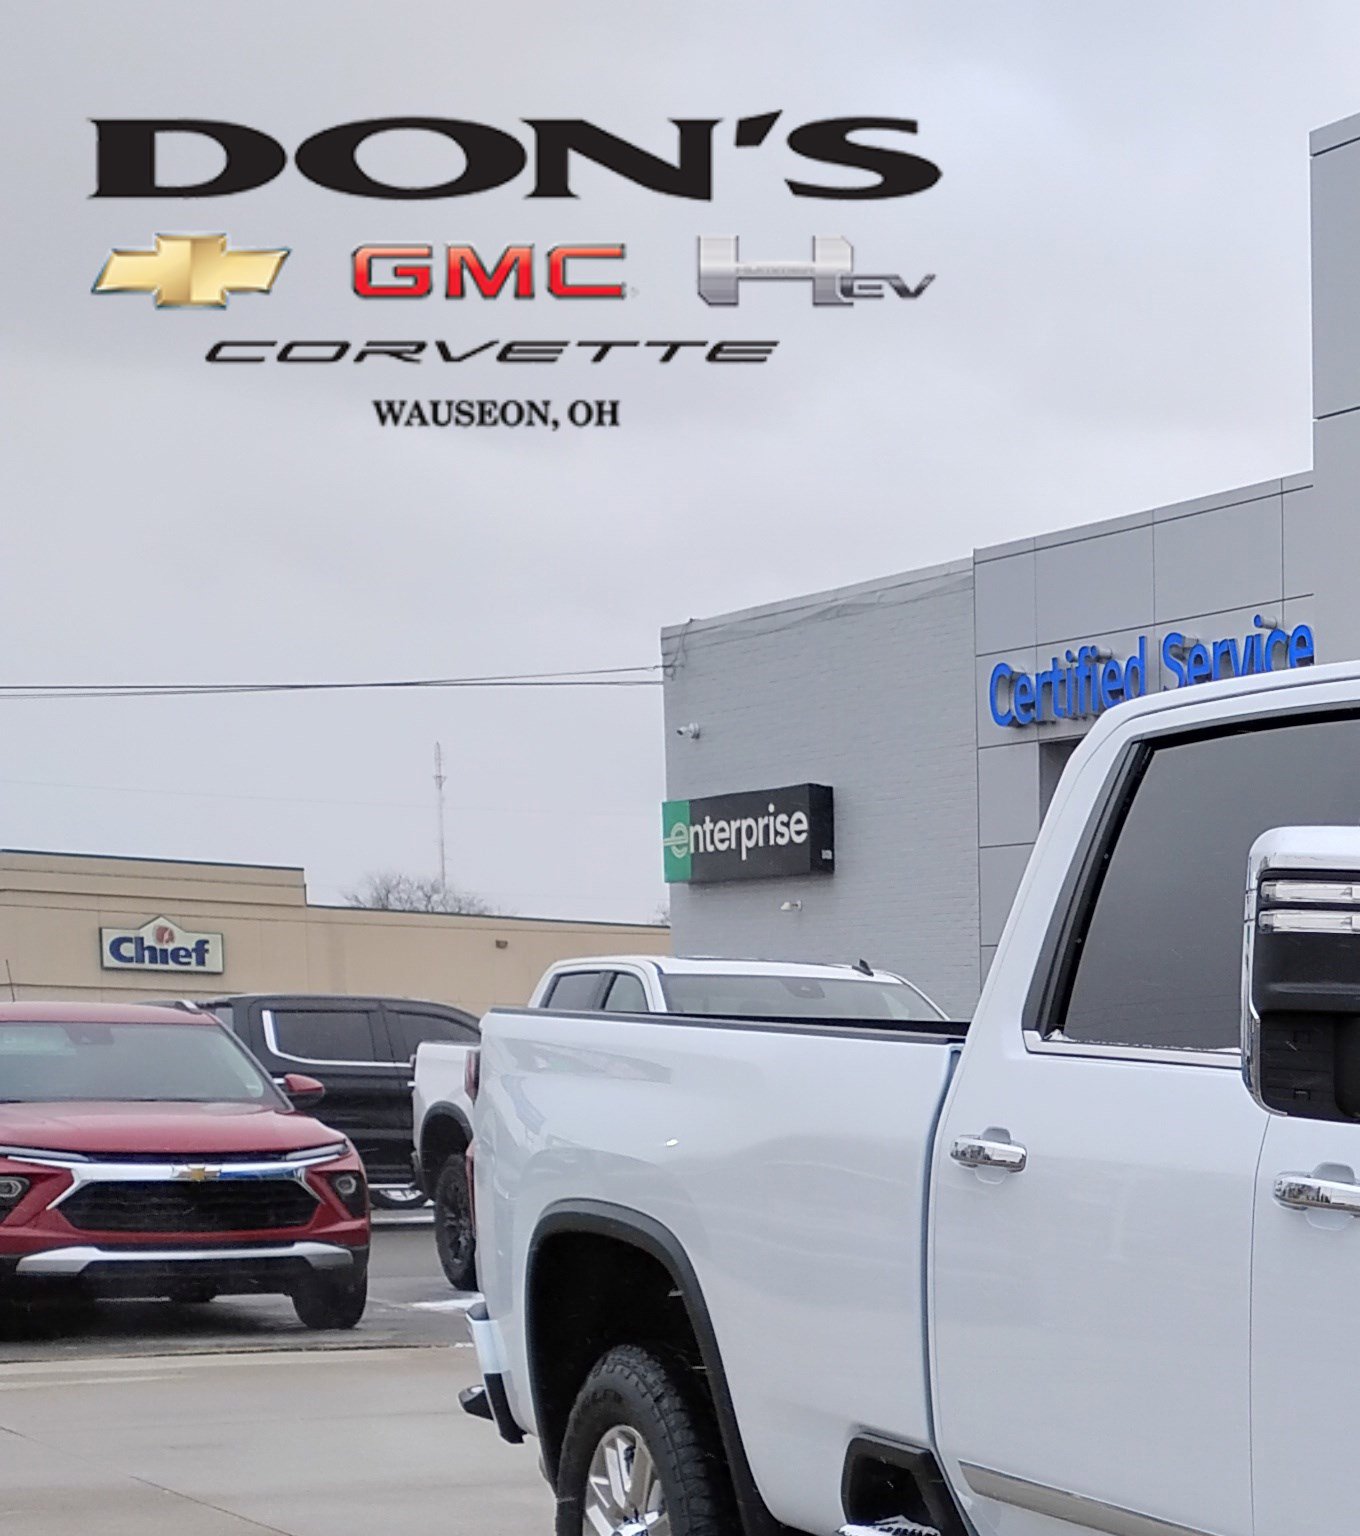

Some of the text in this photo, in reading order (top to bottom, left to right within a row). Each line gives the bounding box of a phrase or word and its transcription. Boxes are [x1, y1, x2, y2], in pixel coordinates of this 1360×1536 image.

[988, 614, 1316, 728] Certified Service
[663, 803, 809, 861] enterprise
[108, 936, 210, 967] Chief
